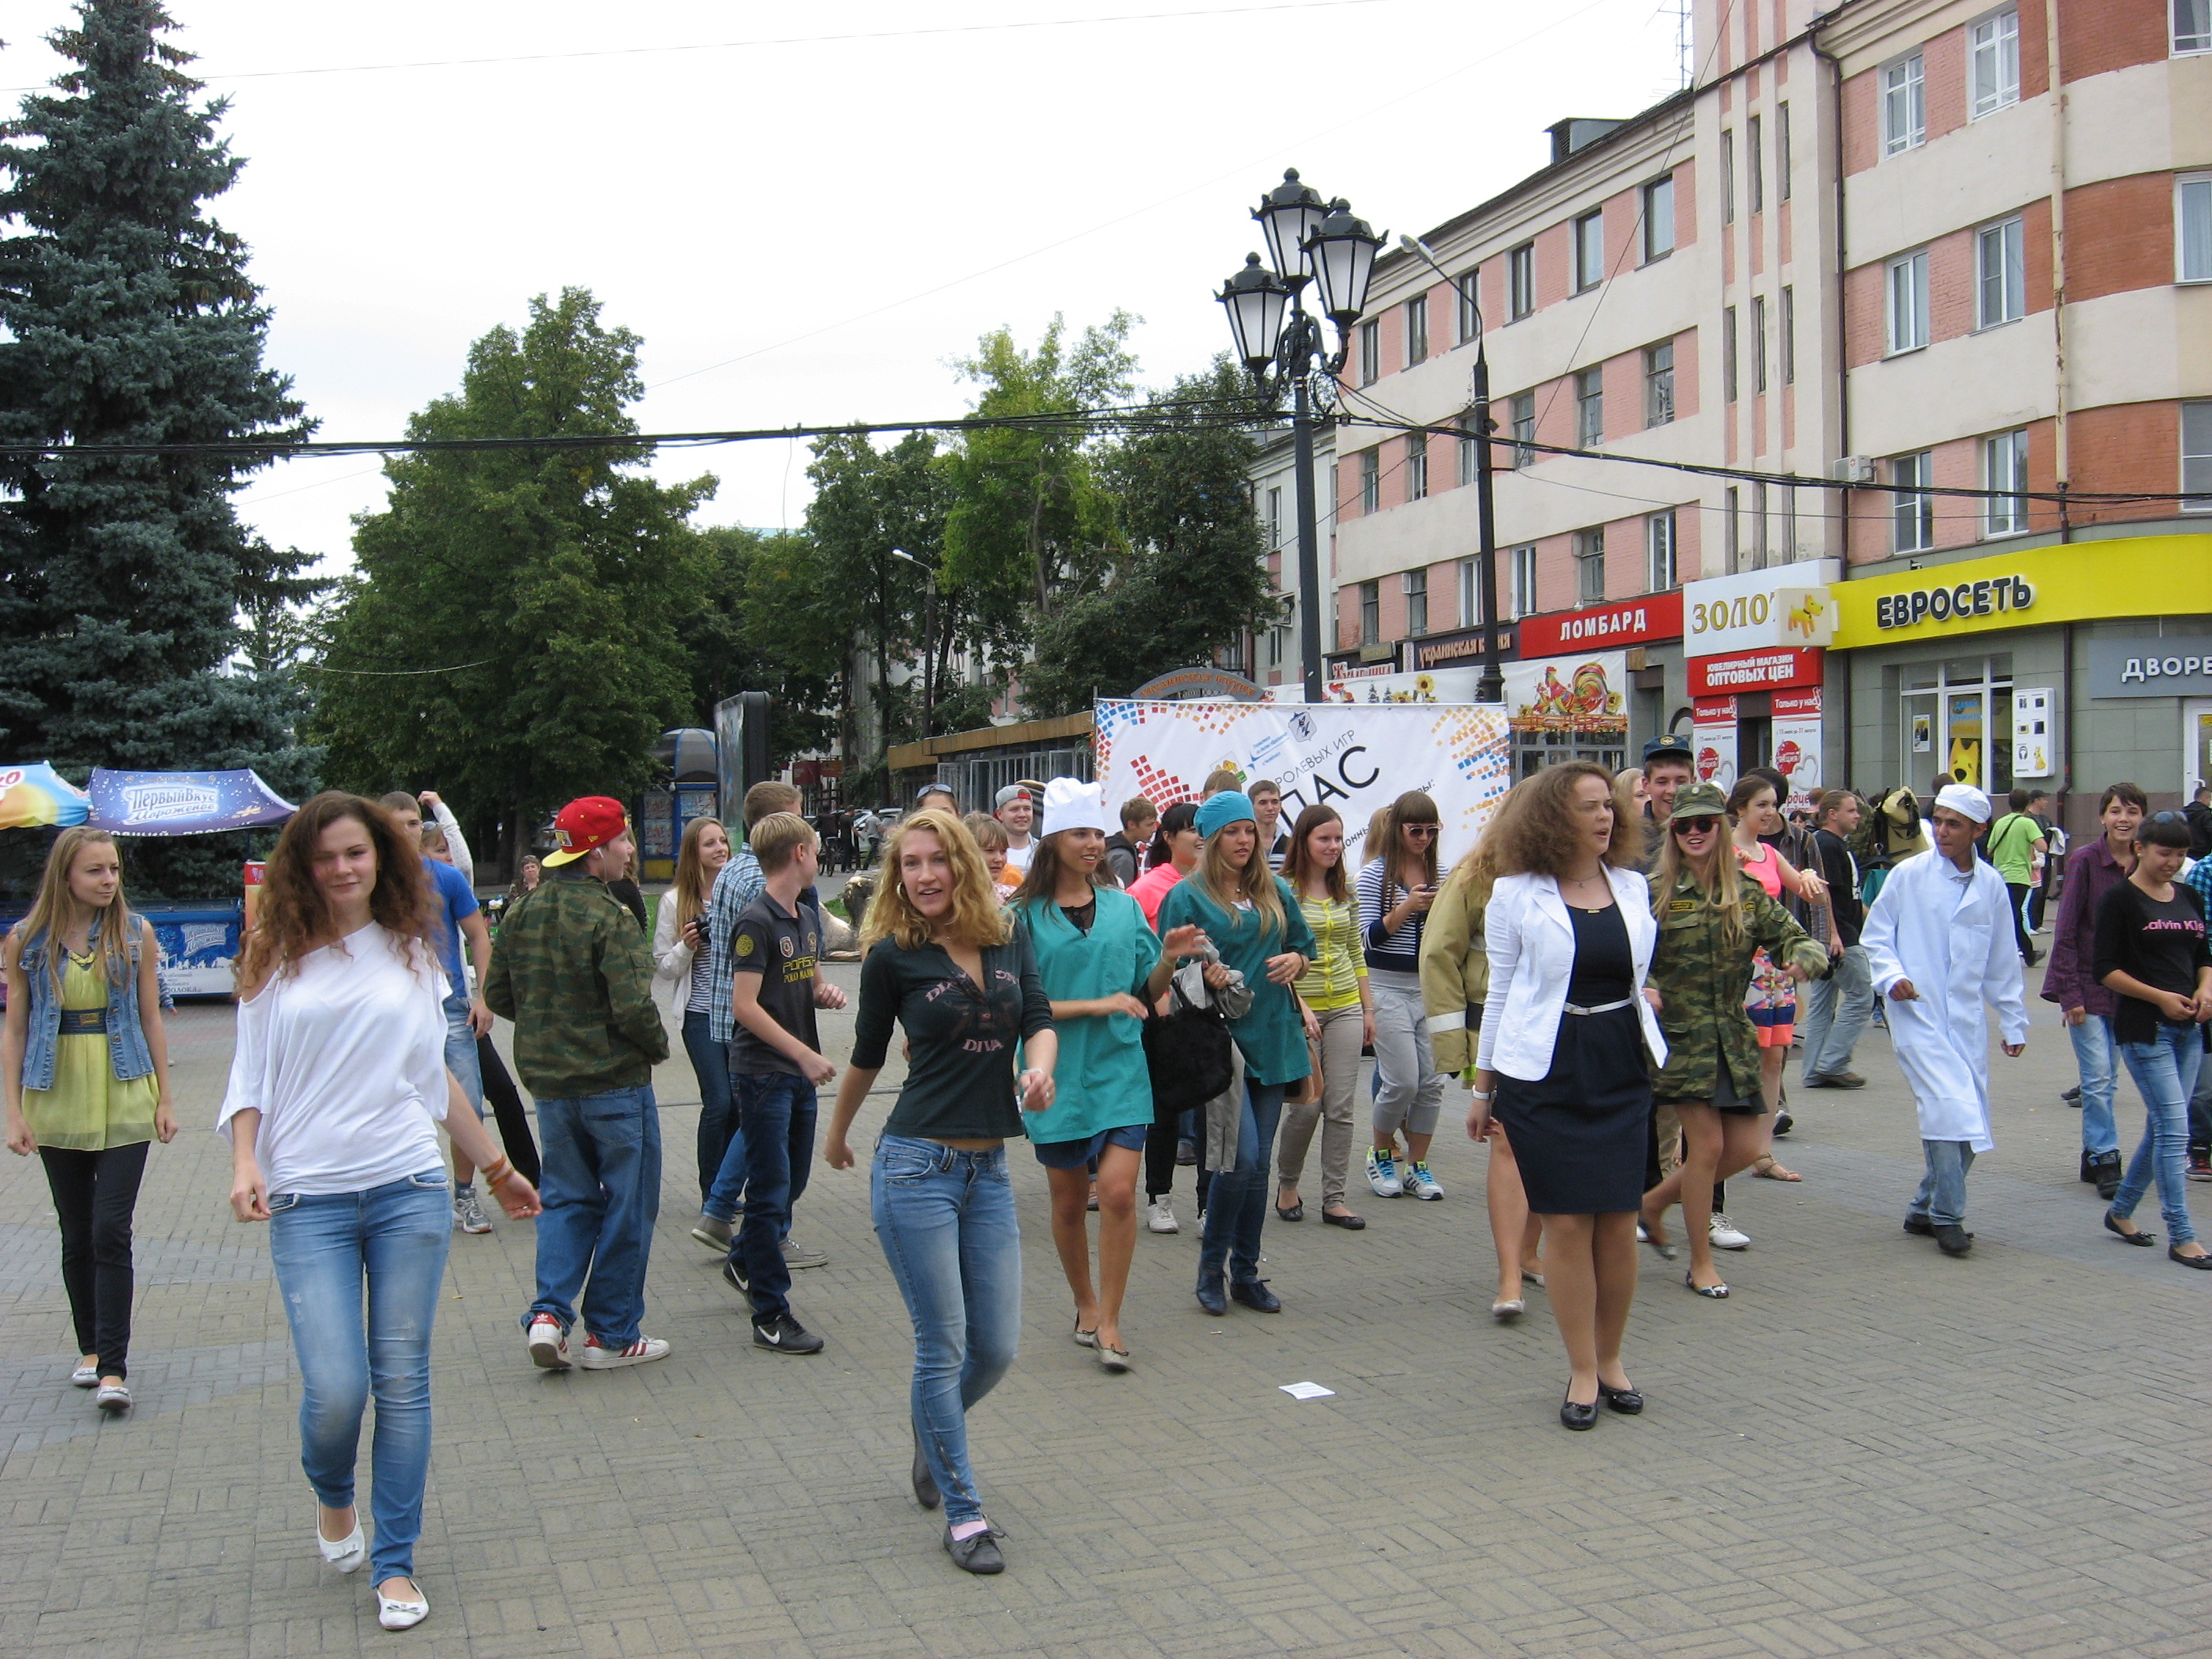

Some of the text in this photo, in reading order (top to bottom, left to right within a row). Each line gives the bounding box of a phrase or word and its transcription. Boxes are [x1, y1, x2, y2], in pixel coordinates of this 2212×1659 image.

[1877, 575, 2033, 628] ЕВРОСЕТЬ
[1559, 608, 1646, 642] ЛОМБАРД
[1691, 593, 1777, 635] ЗОЛО
[1478, 632, 1511, 654] КНЯ
[1707, 654, 1794, 673] ЮВЕЛИРНЫЙ МАГАЗИН
[1706, 664, 1794, 687] ОПТОВЫХ ЦЕН
[1774, 698, 1799, 709] Только
[1798, 699, 1804, 709] у
[1332, 729, 1356, 751] ИГР
[961, 1038, 1005, 1053] DIVA
